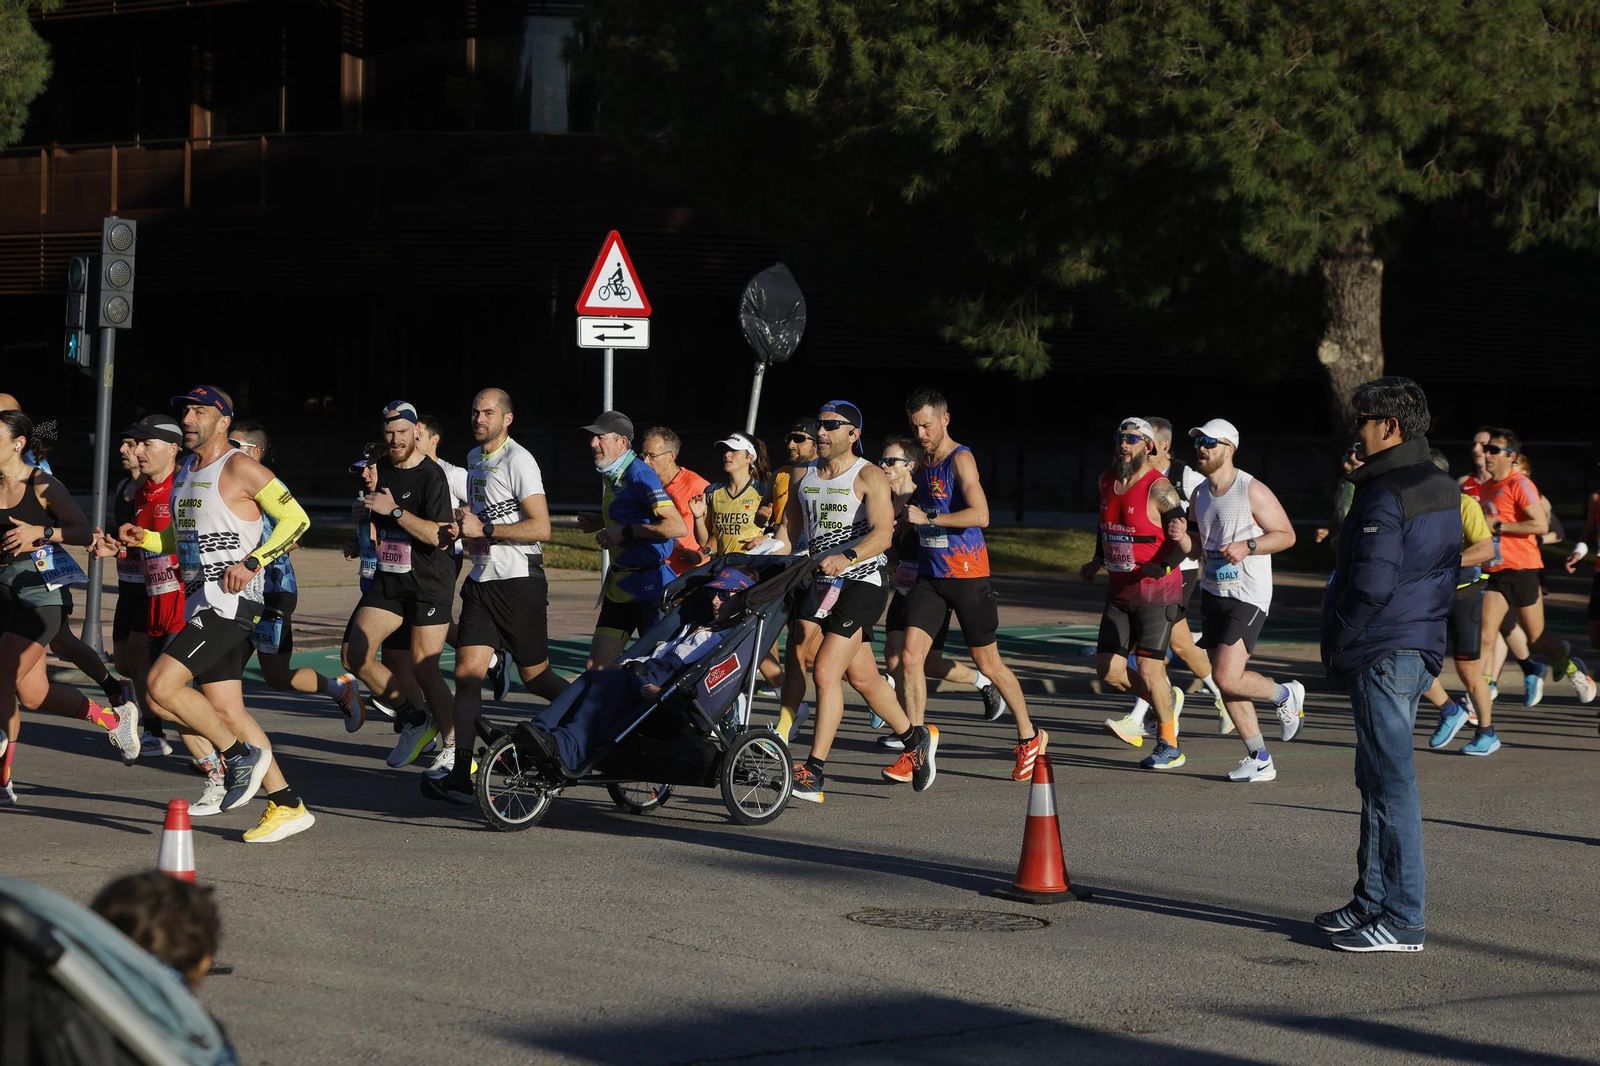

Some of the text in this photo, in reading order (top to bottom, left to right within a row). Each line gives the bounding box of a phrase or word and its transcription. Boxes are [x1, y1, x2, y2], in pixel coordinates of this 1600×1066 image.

[178, 498, 202, 508] CARROS
[820, 503, 848, 512] CARROS
[178, 509, 186, 517] DE
[820, 512, 829, 520] DE
[178, 519, 196, 528] FUEGO
[819, 521, 843, 529] FUEGO
[388, 531, 407, 539] ZURICH
[382, 552, 403, 562] TEDDY
[1219, 570, 1239, 580] DALY
